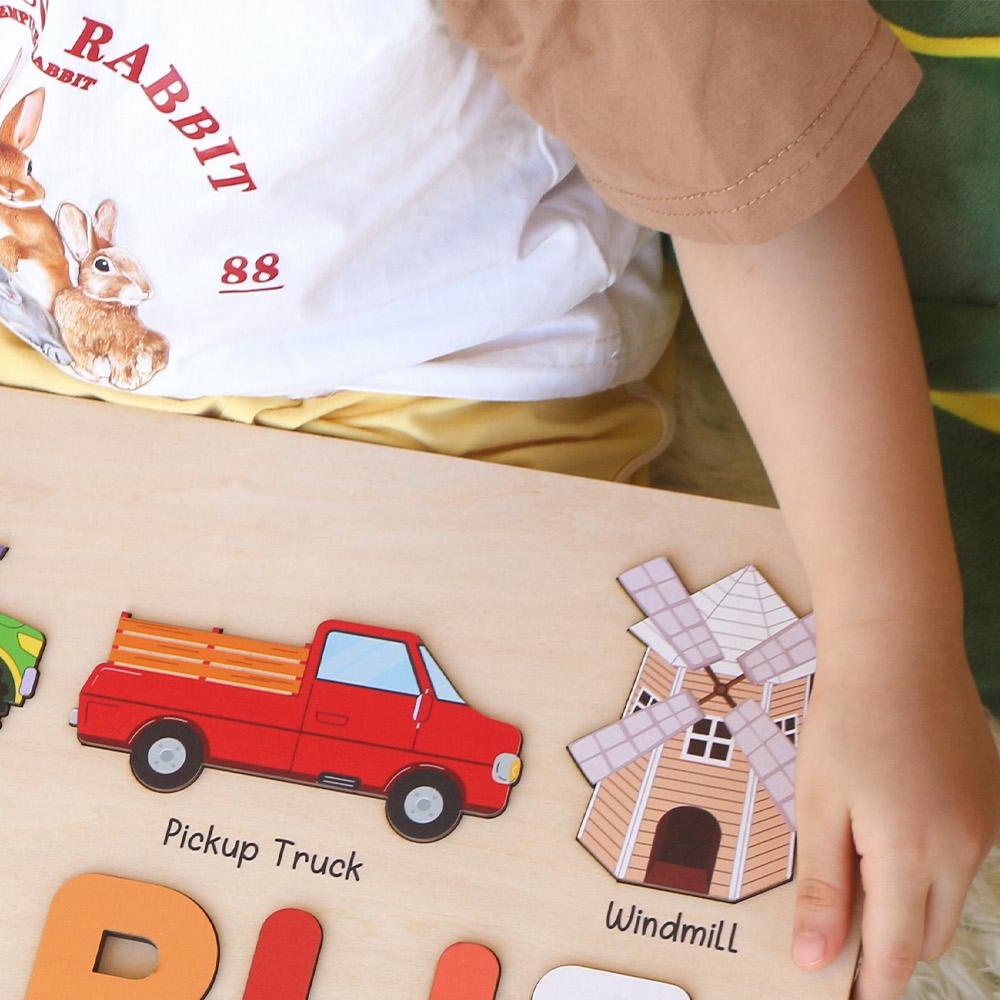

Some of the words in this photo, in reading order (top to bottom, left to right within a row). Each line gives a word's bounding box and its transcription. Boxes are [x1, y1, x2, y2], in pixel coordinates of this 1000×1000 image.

[32, 54, 98, 91] ABBIT
[64, 16, 257, 192] RABBIT
[221, 253, 280, 285] 88
[163, 817, 260, 869] Pickup
[274, 837, 364, 882] Truck
[605, 901, 740, 955] Windmill
